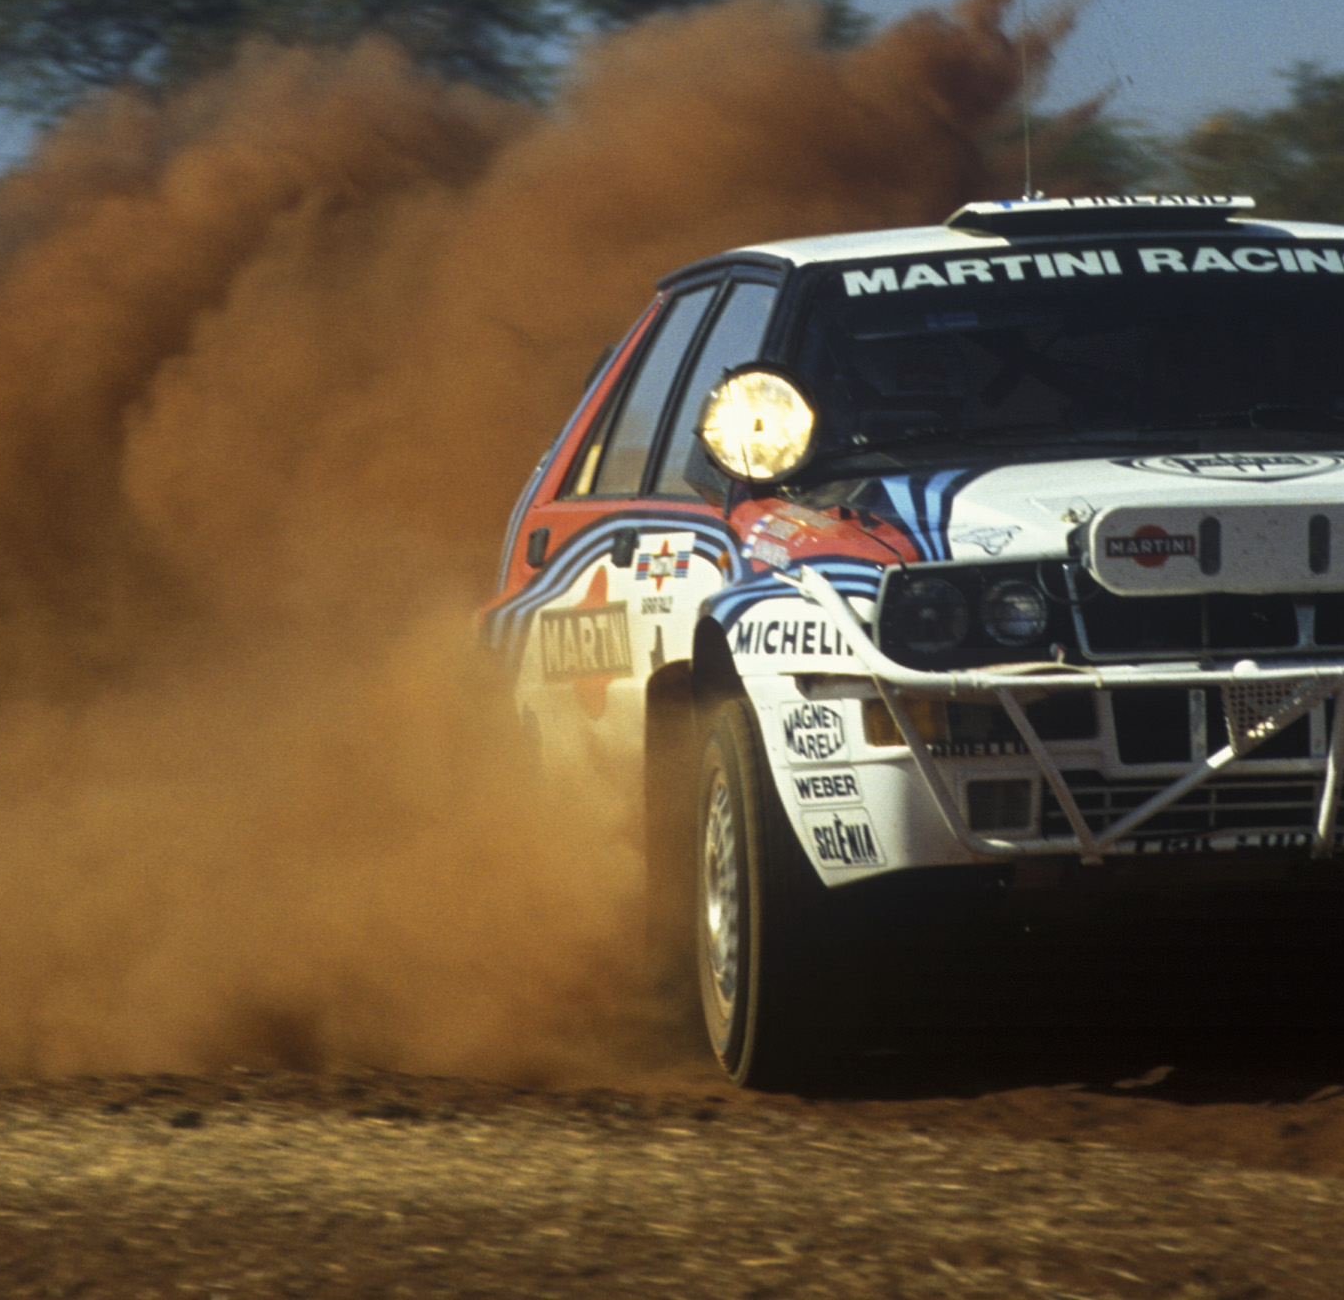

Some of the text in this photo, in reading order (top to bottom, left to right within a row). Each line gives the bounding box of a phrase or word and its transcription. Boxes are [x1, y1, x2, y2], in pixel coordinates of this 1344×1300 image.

[843, 250, 1124, 296] MARTINI
[1108, 538, 1194, 557] MARTINI
[732, 620, 854, 656] MICHELI
[795, 773, 859, 799] WEBER
